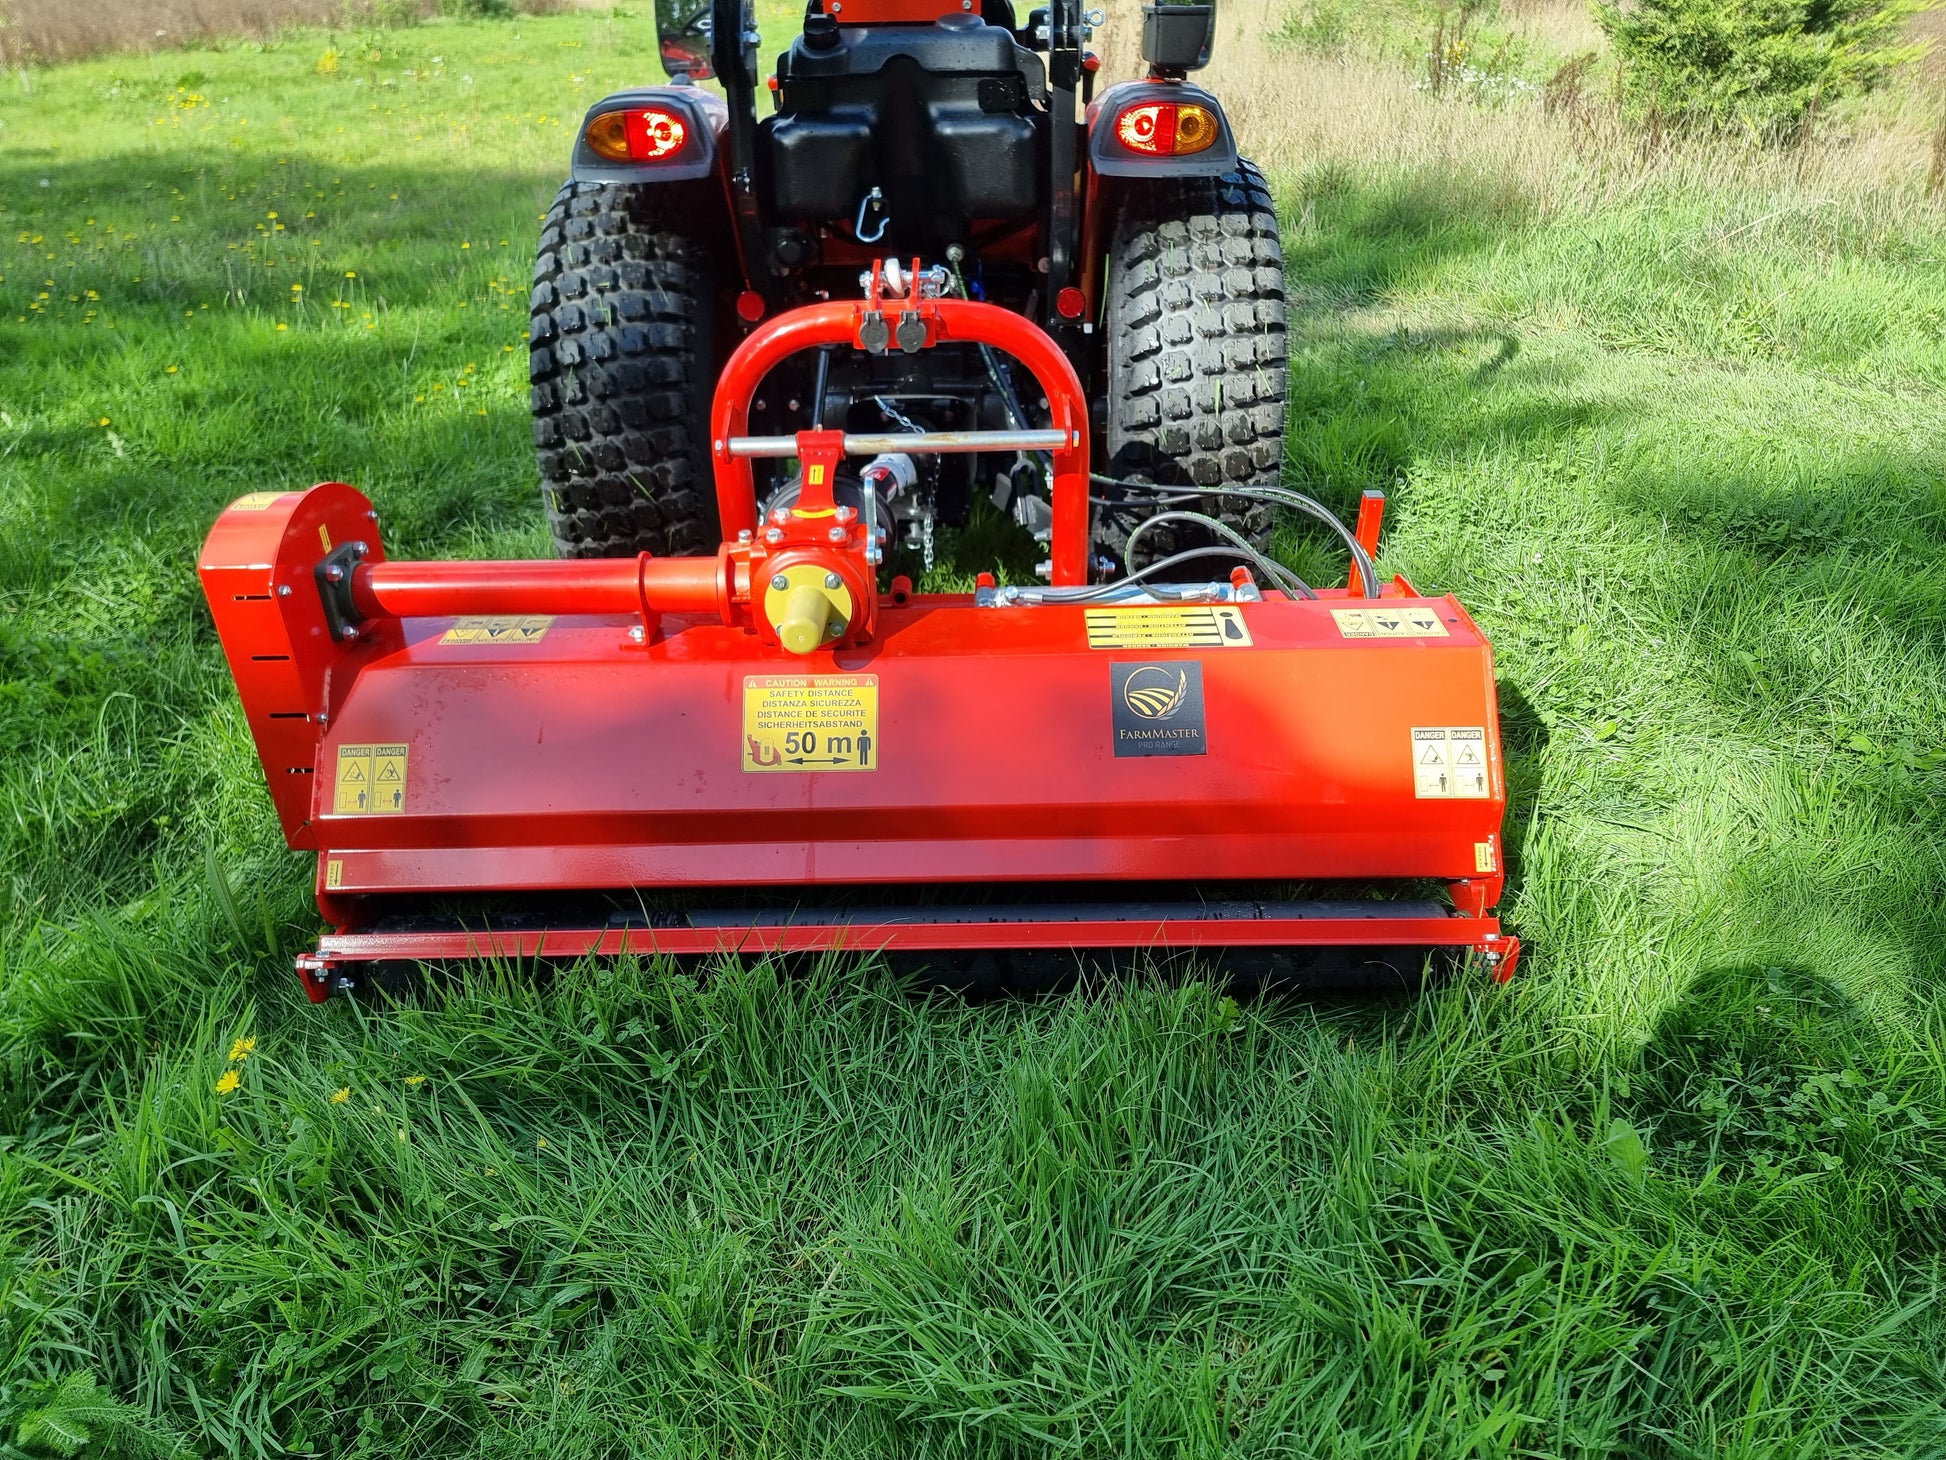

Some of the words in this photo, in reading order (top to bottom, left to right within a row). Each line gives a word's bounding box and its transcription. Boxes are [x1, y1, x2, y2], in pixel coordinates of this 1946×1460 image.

[765, 679, 807, 688] CAUTION
[813, 678, 858, 687] WARNING
[769, 690, 805, 698] SAFETY
[808, 689, 853, 697] DISTANCE
[762, 700, 807, 708] DISTANZA
[809, 699, 861, 707] SICUREZZA
[757, 710, 802, 718] DISTANCE
[805, 710, 818, 718] DE
[820, 709, 867, 717] SECURITE
[757, 720, 863, 729] SICHERHEITSABSTAND
[1414, 731, 1445, 740] DANGER
[1451, 731, 1482, 739] DANGER
[784, 731, 817, 755] 50
[827, 736, 852, 754] m
[1138, 741, 1154, 749] PRO
[1155, 740, 1180, 749] RANGE
[341, 748, 370, 757] DANGER
[376, 747, 405, 756] DANGER
